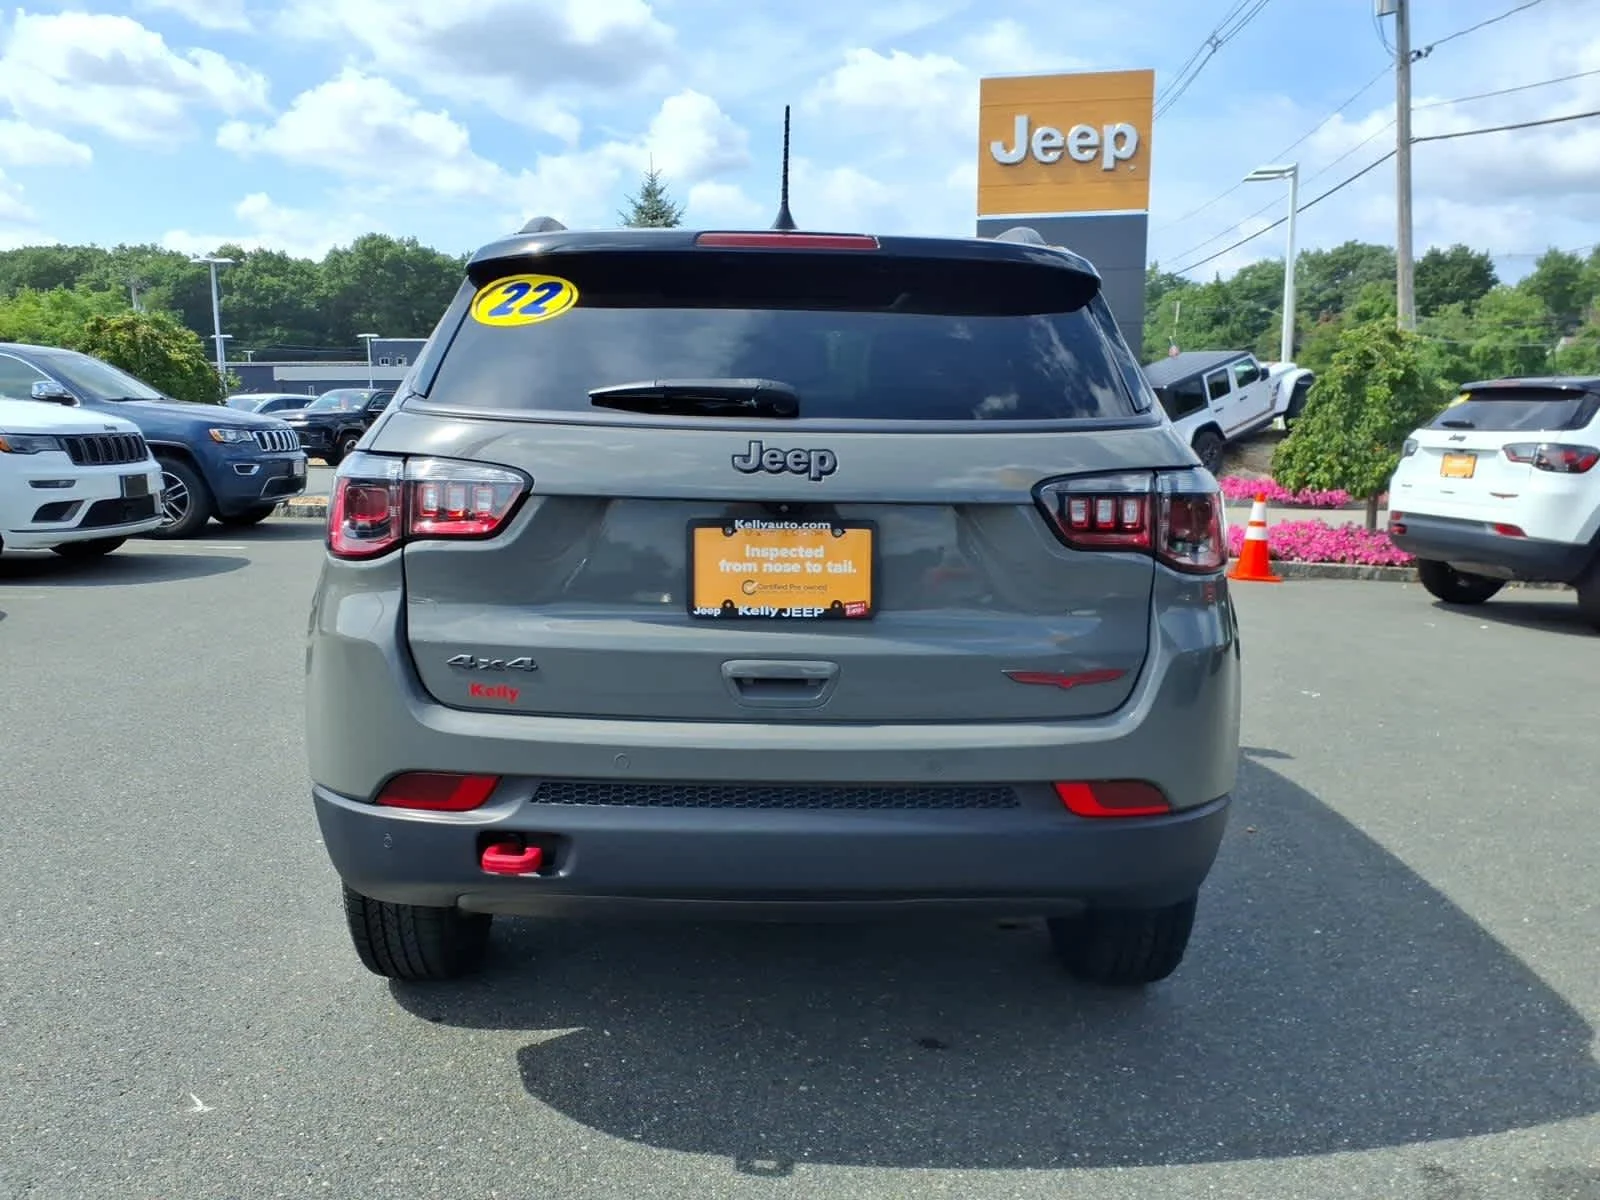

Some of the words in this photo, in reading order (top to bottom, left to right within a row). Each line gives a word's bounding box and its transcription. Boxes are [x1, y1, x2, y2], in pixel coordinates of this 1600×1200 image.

[990, 114, 1138, 170] Jeep
[488, 282, 564, 316] 22
[732, 440, 837, 481] Jeep
[734, 519, 831, 530] Kellyauto.com
[745, 544, 825, 560] Inspected
[719, 560, 758, 573] from
[762, 561, 801, 574] nose
[805, 560, 823, 574] to
[826, 559, 857, 574] tail.
[693, 606, 721, 616] Jeep
[738, 605, 780, 618] Kelly
[781, 607, 825, 618] JEEP
[447, 654, 538, 672] 4x4
[469, 682, 519, 703] Kelly
